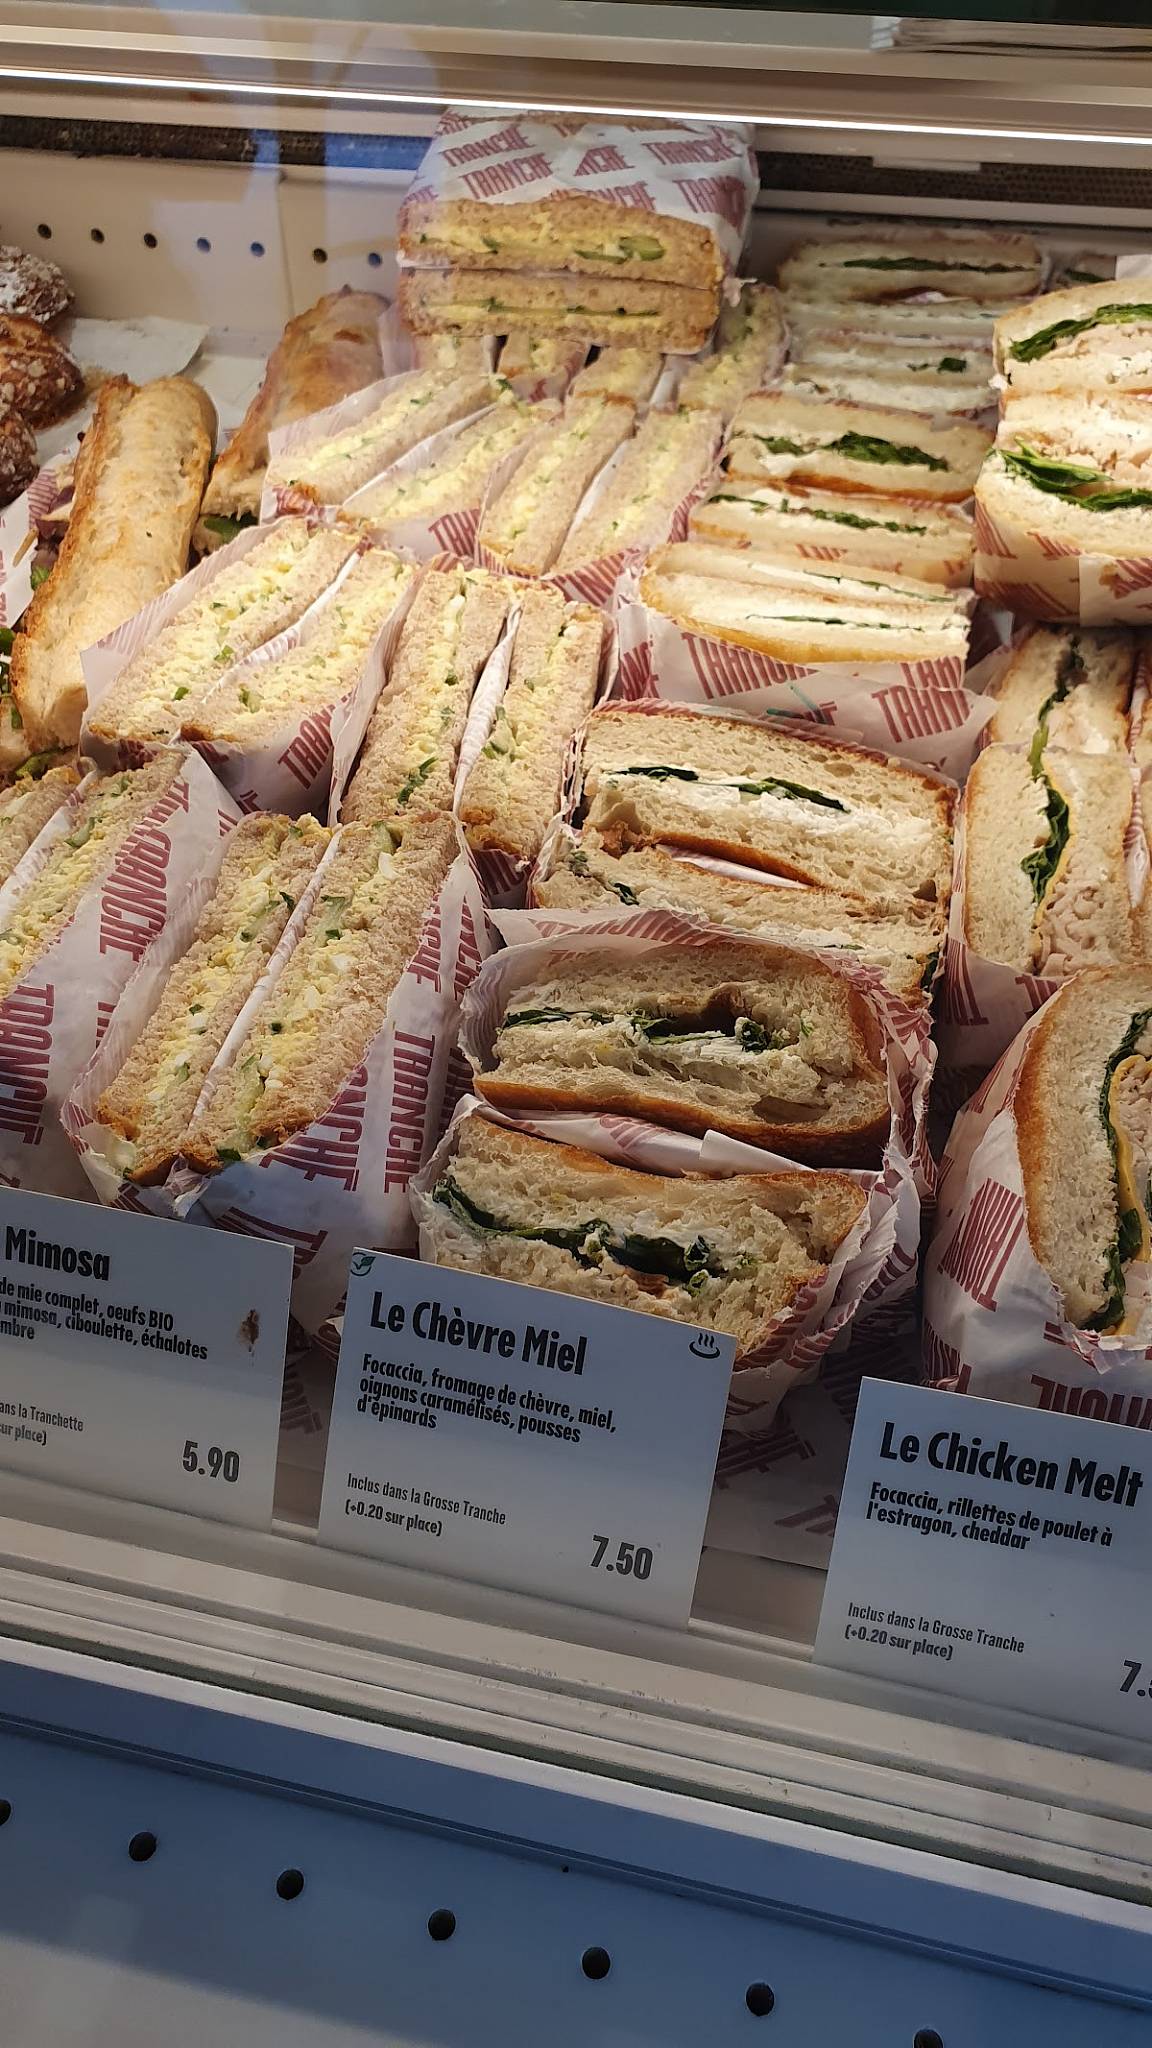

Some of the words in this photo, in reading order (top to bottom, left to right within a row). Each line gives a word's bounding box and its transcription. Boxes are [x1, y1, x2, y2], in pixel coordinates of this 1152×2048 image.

[440, 123, 537, 168] TRANCHE
[460, 152, 554, 200] TRANCHE
[384, 1030, 436, 1194] TRANCHE
[5, 1225, 111, 1281] Mimosa
[0, 1317, 35, 1340] mbre
[4, 1300, 62, 1329] mimosa,
[65, 1313, 139, 1346] ciboulette,
[141, 1328, 208, 1360] échalotes
[17, 1283, 43, 1303] mie
[44, 1293, 105, 1319] complet,
[106, 1305, 146, 1326] oeufs
[148, 1309, 175, 1332] BIO
[370, 1291, 406, 1333] Le
[412, 1301, 517, 1359] Chèvre
[521, 1325, 588, 1376] Miel
[0, 1402, 16, 1416] ans
[18, 1403, 28, 1418] la
[30, 1406, 84, 1432] Tranchette
[359, 1375, 418, 1404] oignons
[420, 1391, 515, 1430] caramélisés,
[517, 1414, 582, 1443] pousses
[362, 1353, 428, 1388] Focaccia,
[431, 1367, 496, 1402] fromage
[498, 1383, 517, 1406] de
[519, 1389, 575, 1423] chèvre,
[578, 1406, 617, 1434] miel,
[15, 1424, 47, 1447] place)
[181, 1440, 241, 1483] 5.90
[879, 1420, 921, 1465] Le
[927, 1431, 1059, 1492] Chicken
[1065, 1456, 1145, 1508] Melt
[347, 1473, 380, 1494] Inclus
[382, 1481, 409, 1501] dans
[410, 1487, 421, 1504] la
[423, 1490, 461, 1514] Grosse
[463, 1500, 507, 1526] Tranche
[384, 1510, 406, 1527] sur
[405, 1514, 443, 1537] place)
[870, 1481, 944, 1515] Focaccia,
[947, 1497, 1017, 1527] rillettes
[1019, 1510, 1041, 1532] de
[1042, 1520, 1099, 1544] poulet
[1100, 1526, 1114, 1547] à
[866, 1501, 958, 1539] l'estragon,
[961, 1521, 1031, 1550] cheddar
[590, 1534, 654, 1581] 7.50
[848, 1602, 885, 1623] Inclus
[887, 1610, 916, 1630] dans
[918, 1616, 930, 1632] la
[932, 1619, 974, 1642] Grosse
[976, 1628, 1026, 1654] Tranche
[888, 1635, 912, 1650] sur
[912, 1638, 954, 1661] place)
